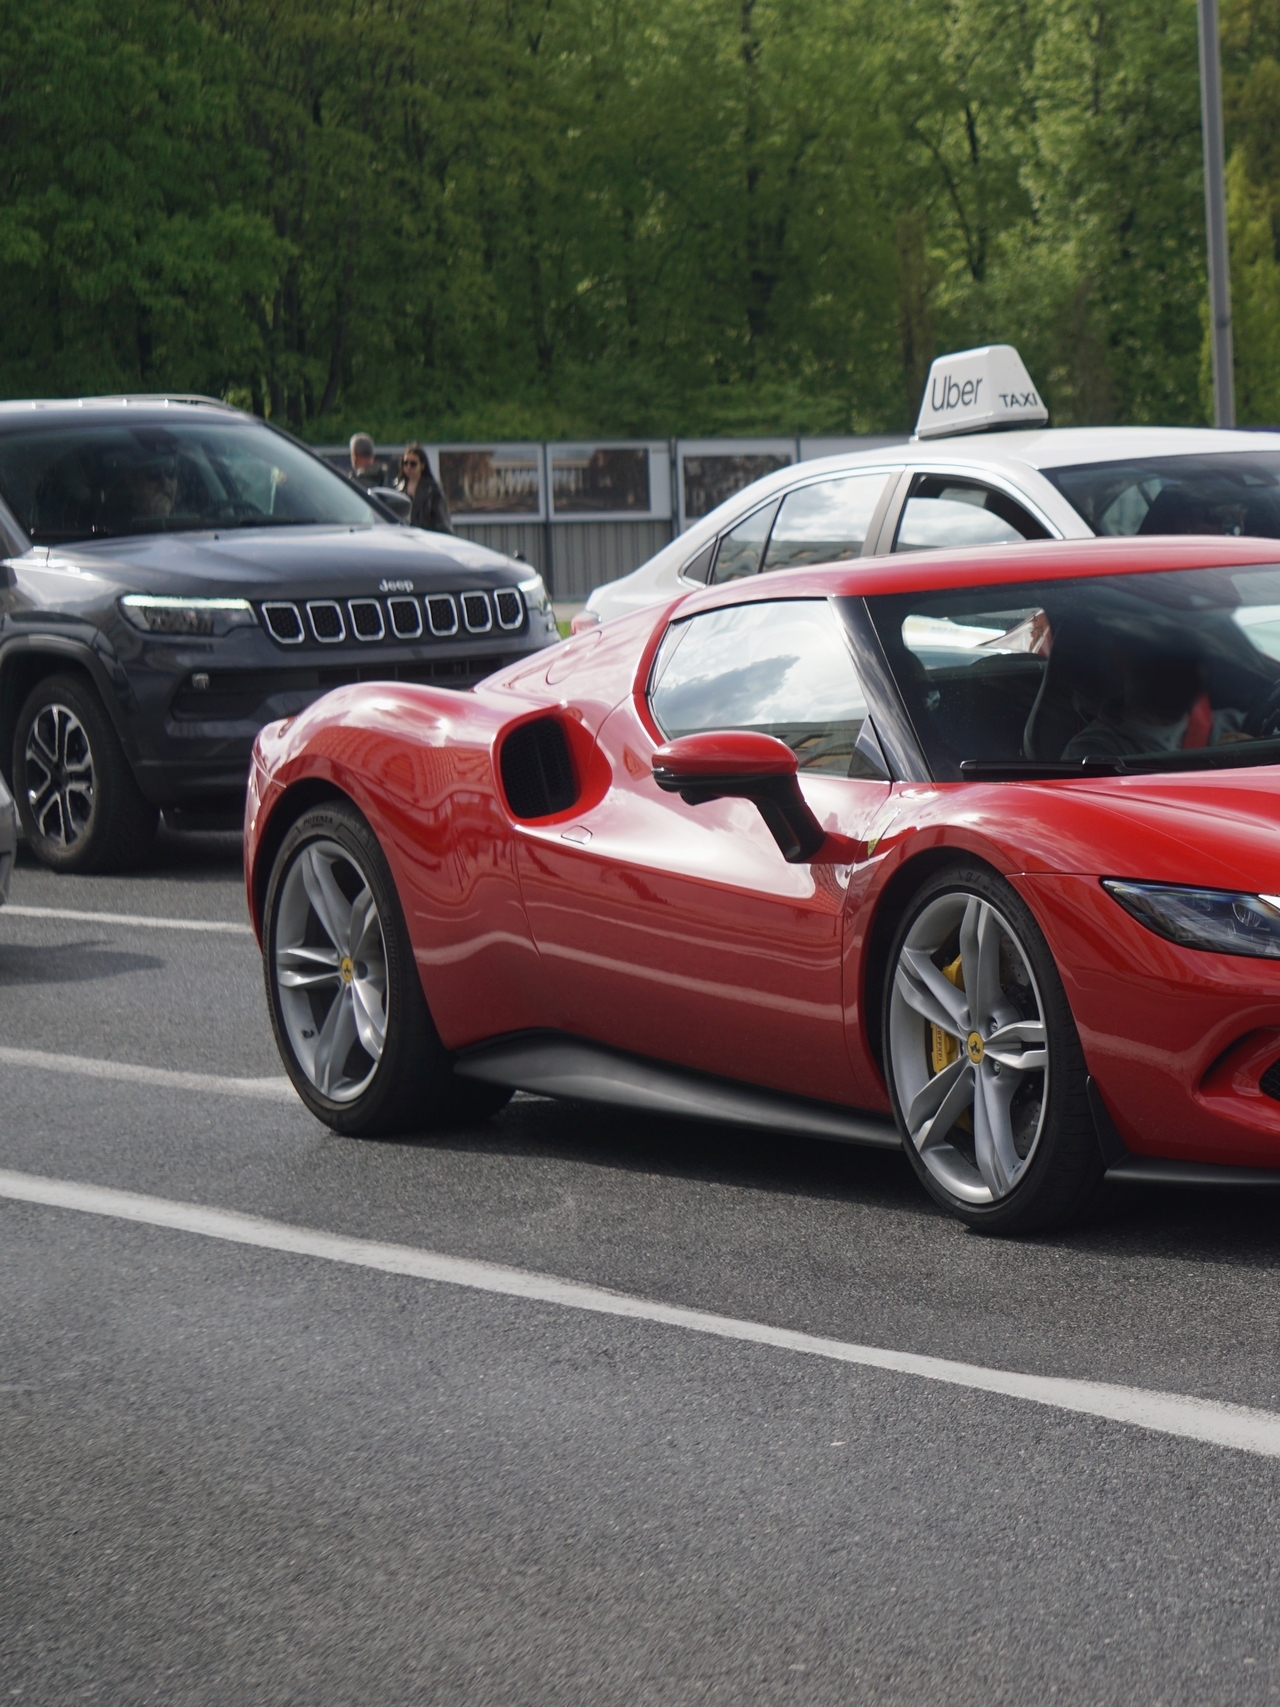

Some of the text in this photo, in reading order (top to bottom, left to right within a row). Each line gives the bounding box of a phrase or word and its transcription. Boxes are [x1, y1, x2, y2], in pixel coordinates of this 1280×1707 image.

[931, 375, 983, 412] Uber
[999, 392, 1038, 408] TAXI
[379, 578, 414, 593] Jeep
